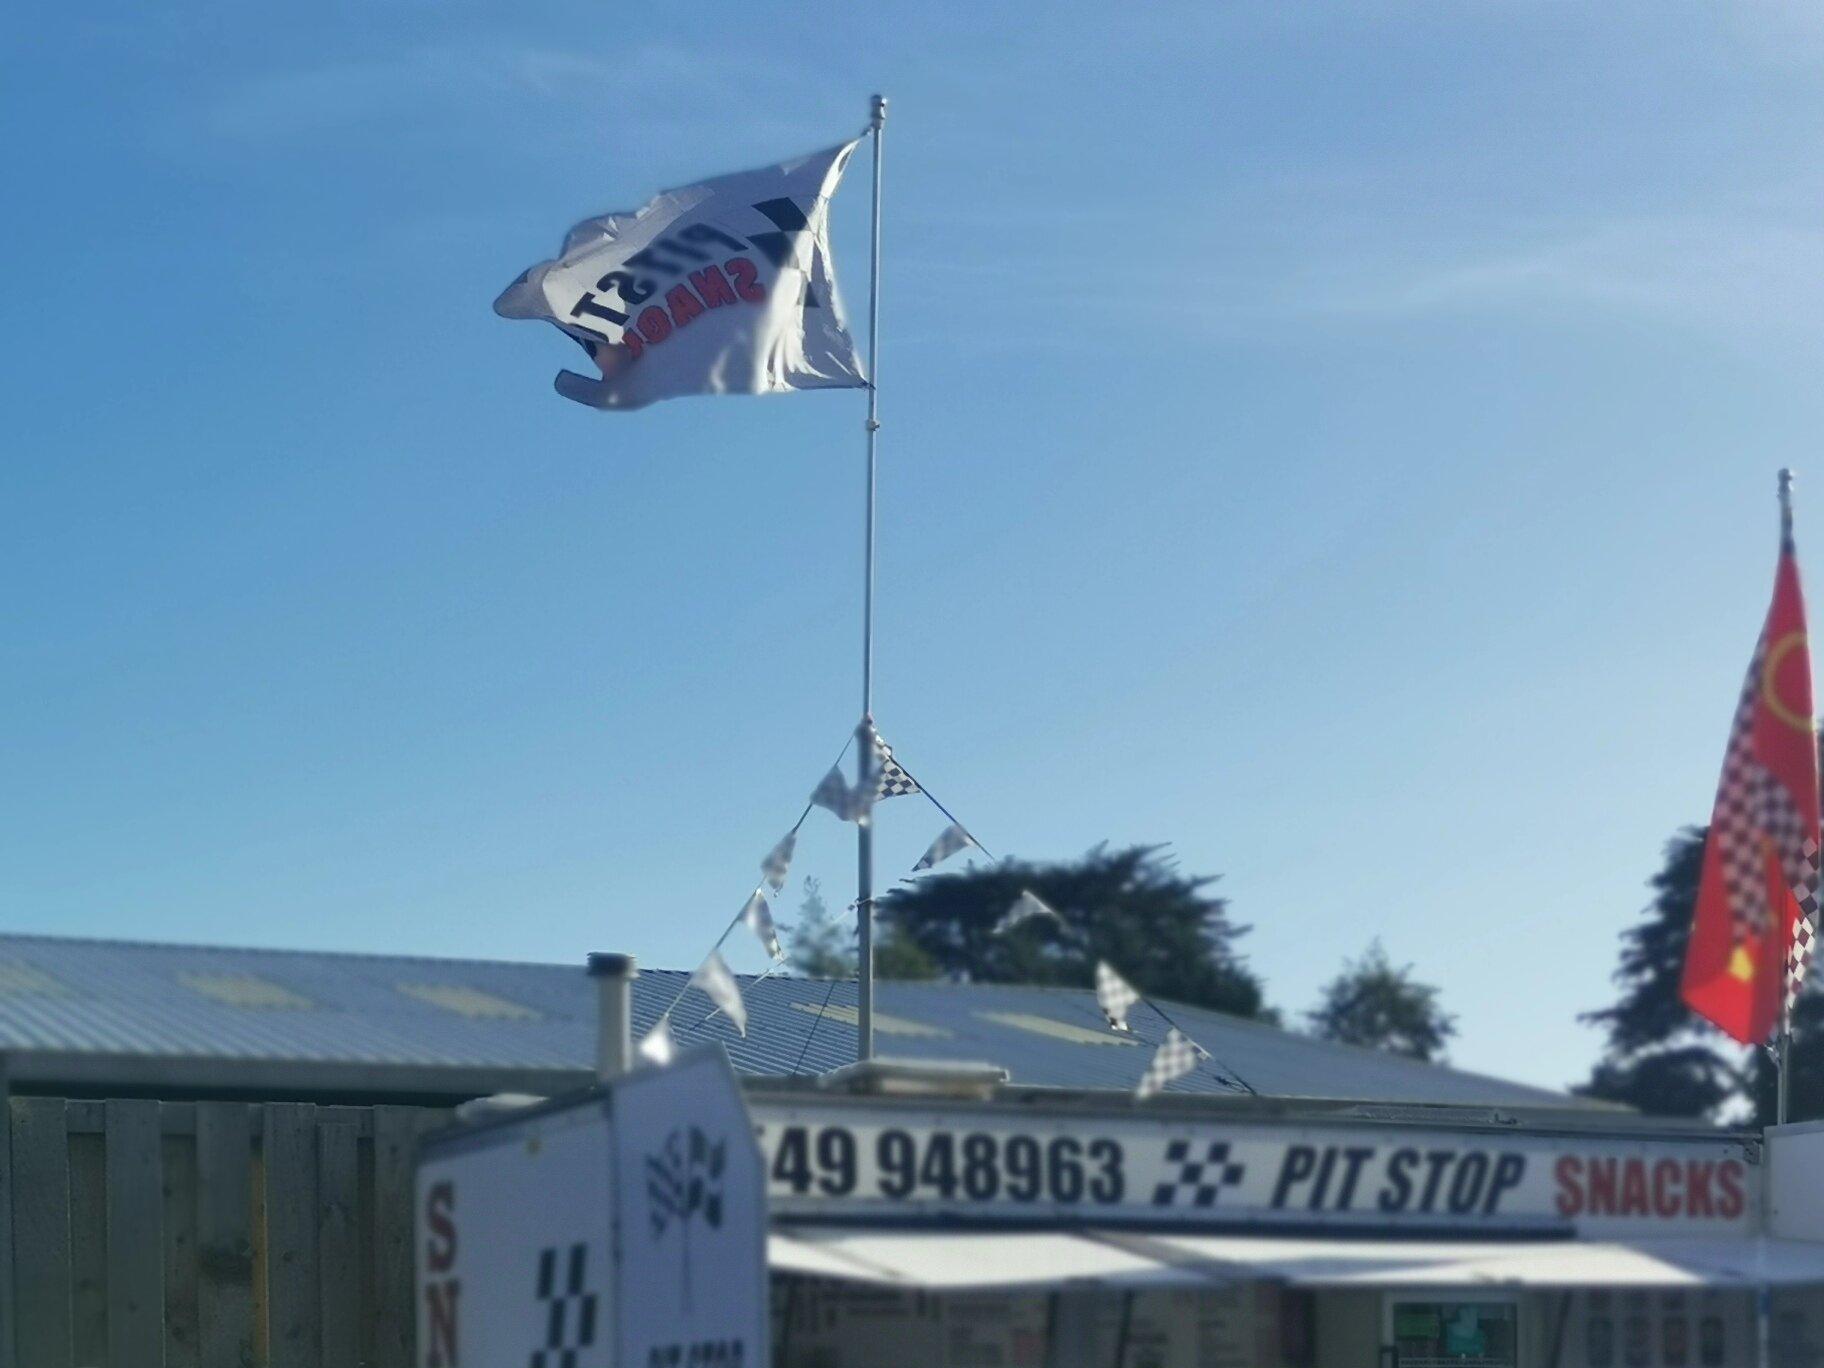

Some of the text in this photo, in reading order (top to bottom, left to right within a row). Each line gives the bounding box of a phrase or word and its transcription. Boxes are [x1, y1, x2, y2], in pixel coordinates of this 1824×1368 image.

[754, 1125, 1126, 1207] 49 948963
[1268, 1144, 1746, 1220] PIT STOP SNACKS
